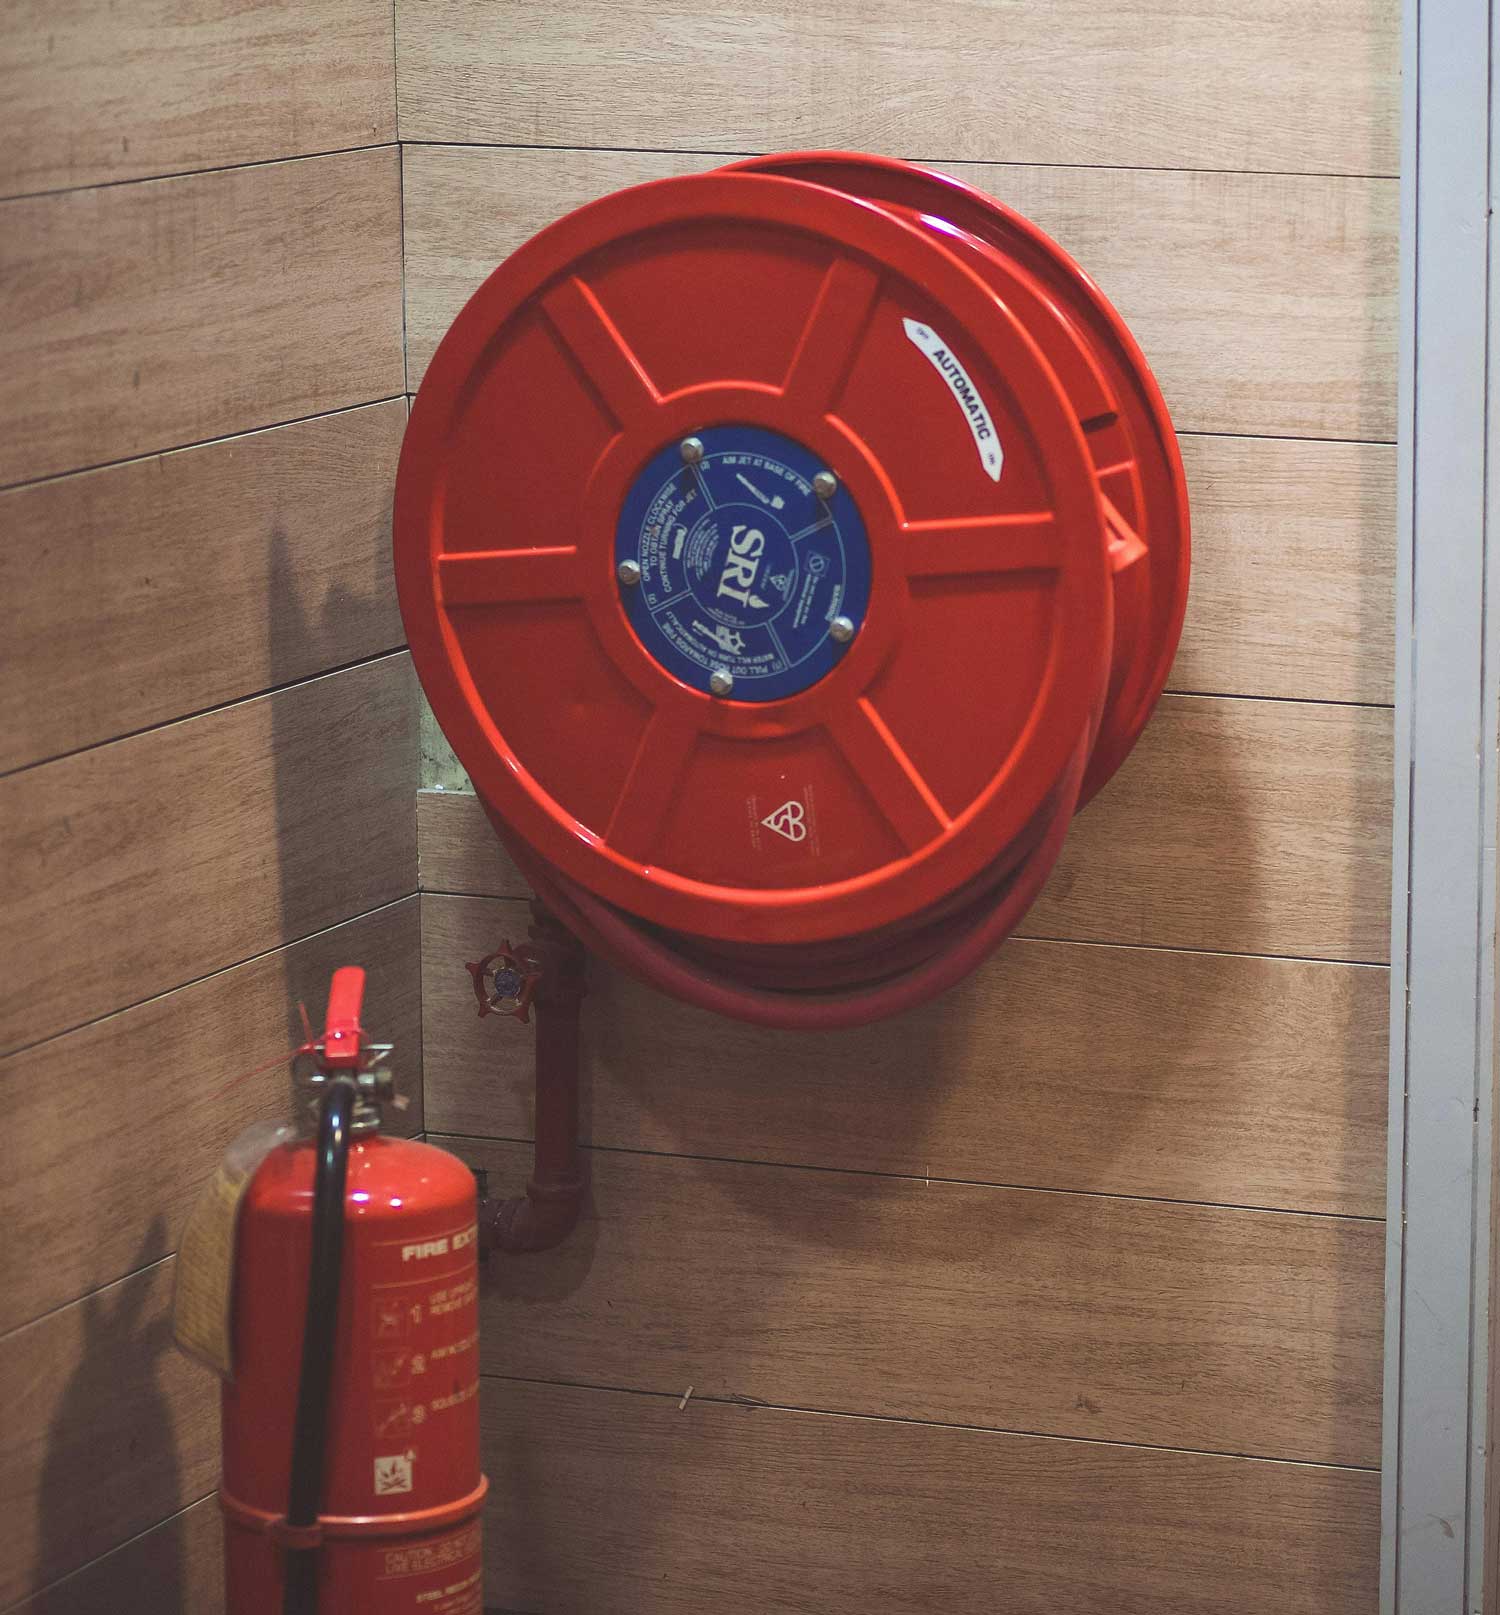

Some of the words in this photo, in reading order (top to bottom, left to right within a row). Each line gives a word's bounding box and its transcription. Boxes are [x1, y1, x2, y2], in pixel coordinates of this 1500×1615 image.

[933, 350, 991, 440] AUTOMATIC
[722, 456, 737, 465] AIM
[738, 456, 752, 465] JET
[753, 458, 763, 467] AT
[764, 461, 785, 477] BASE
[784, 472, 796, 482] OF
[795, 480, 811, 496] FIRE
[647, 482, 677, 525] CLOCKWISE
[685, 488, 698, 503] JET
[656, 499, 674, 525] SPRAY
[642, 526, 652, 558] NOZZLE
[649, 523, 662, 555] OBTAIN
[660, 514, 677, 550] TURNING
[642, 559, 651, 581] OPEN
[650, 556, 658, 566] TO
[659, 551, 672, 593] CONTINUE
[716, 525, 768, 608] SRI
[731, 666, 748, 675] OUT
[749, 665, 768, 675] PULL
[402, 1238, 449, 1262] FIRE
